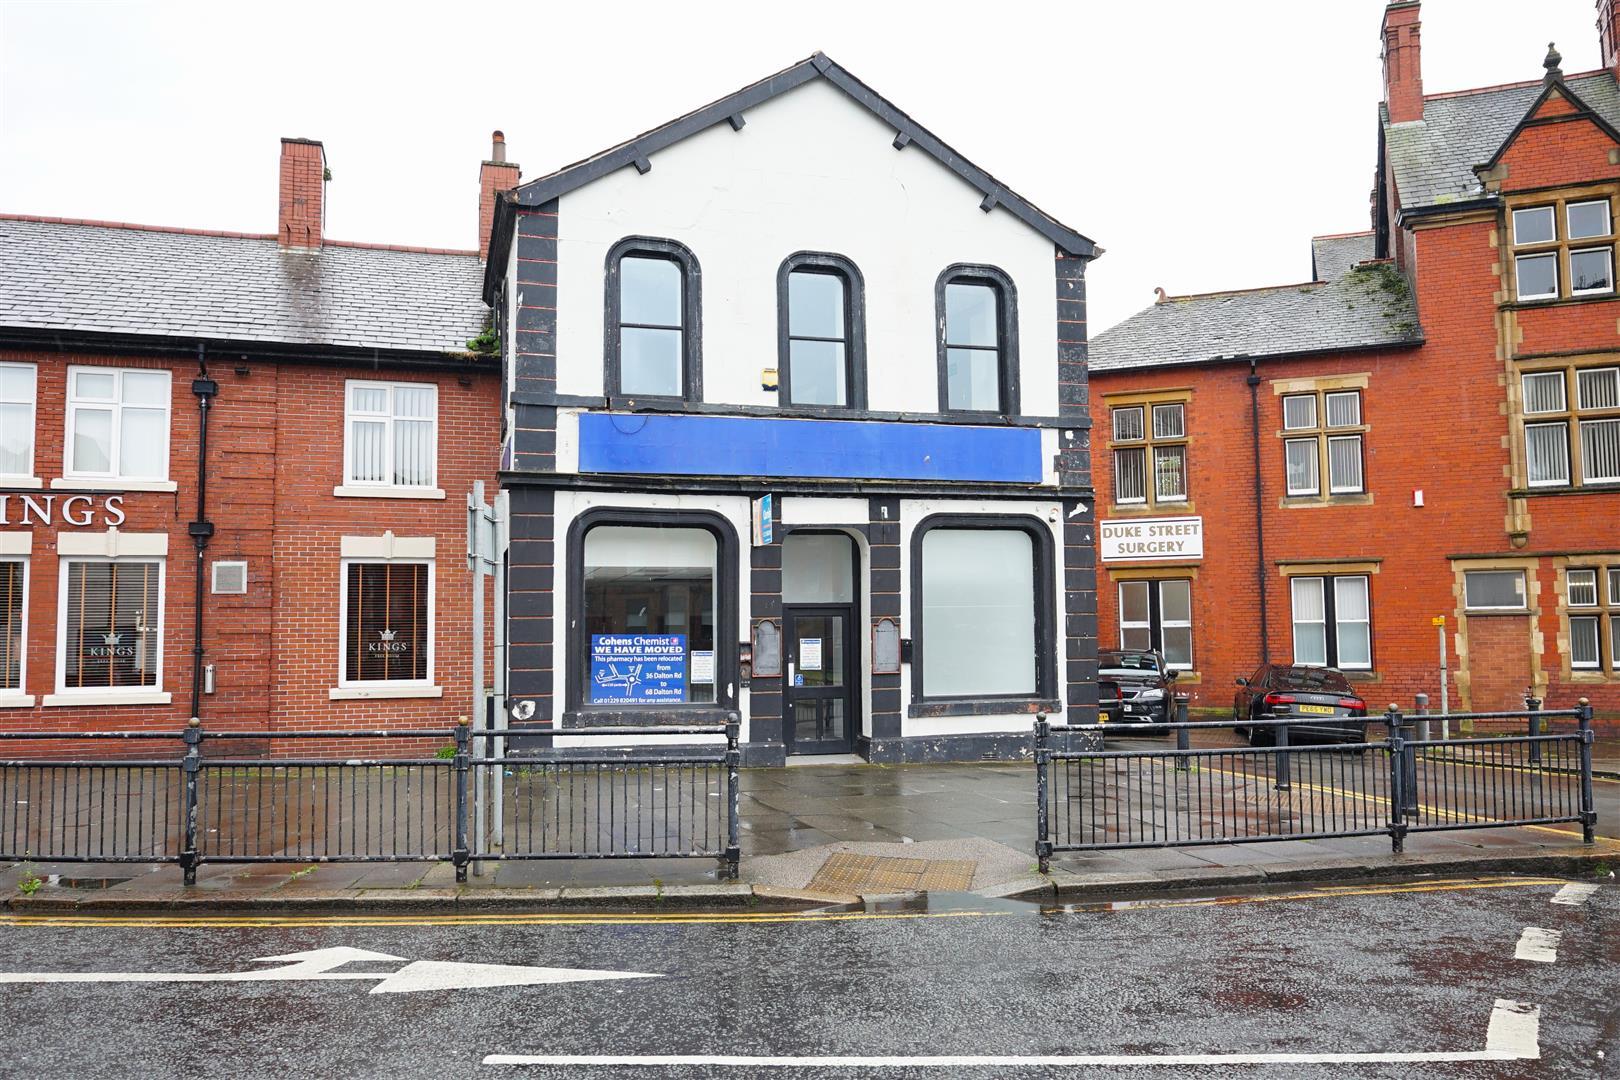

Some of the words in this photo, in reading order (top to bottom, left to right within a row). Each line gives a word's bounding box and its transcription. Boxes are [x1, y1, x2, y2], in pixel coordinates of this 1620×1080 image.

[1102, 526, 1142, 539] DUKE
[1148, 524, 1200, 537] STREET
[1117, 540, 1185, 554] SURGERY
[599, 636, 632, 646] Cohens
[633, 636, 669, 646] Chemist
[368, 642, 407, 651] KINGS
[594, 646, 611, 654] WE
[613, 646, 643, 654] HAVE
[644, 646, 683, 654] MOVED
[90, 647, 134, 656] KINGS
